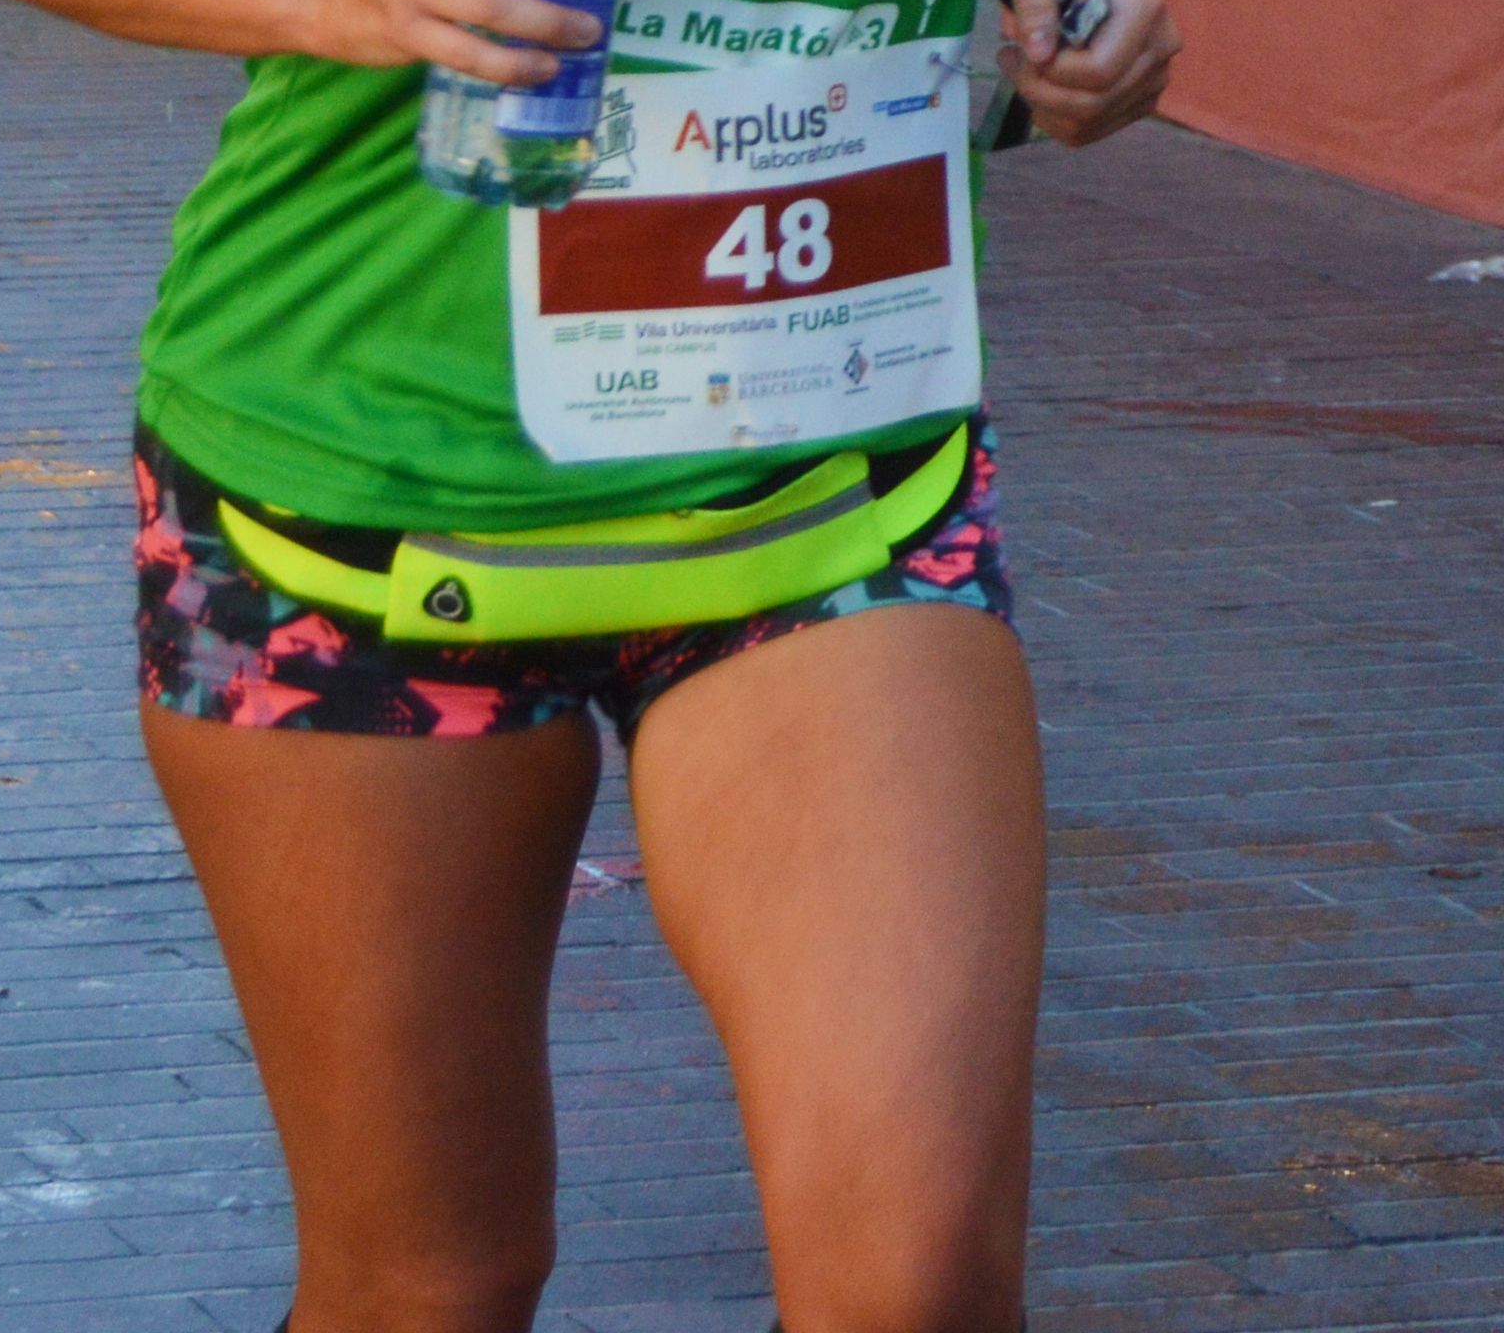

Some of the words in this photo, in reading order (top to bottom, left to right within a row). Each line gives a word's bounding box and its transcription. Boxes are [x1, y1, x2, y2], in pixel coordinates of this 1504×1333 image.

[614, 1, 665, 38] La
[681, 10, 832, 58] Marató
[749, 134, 866, 172] laboratories
[703, 199, 833, 291] 48
[635, 321, 668, 339] Vila
[787, 304, 851, 333] FUAB
[595, 368, 660, 393] UAB
